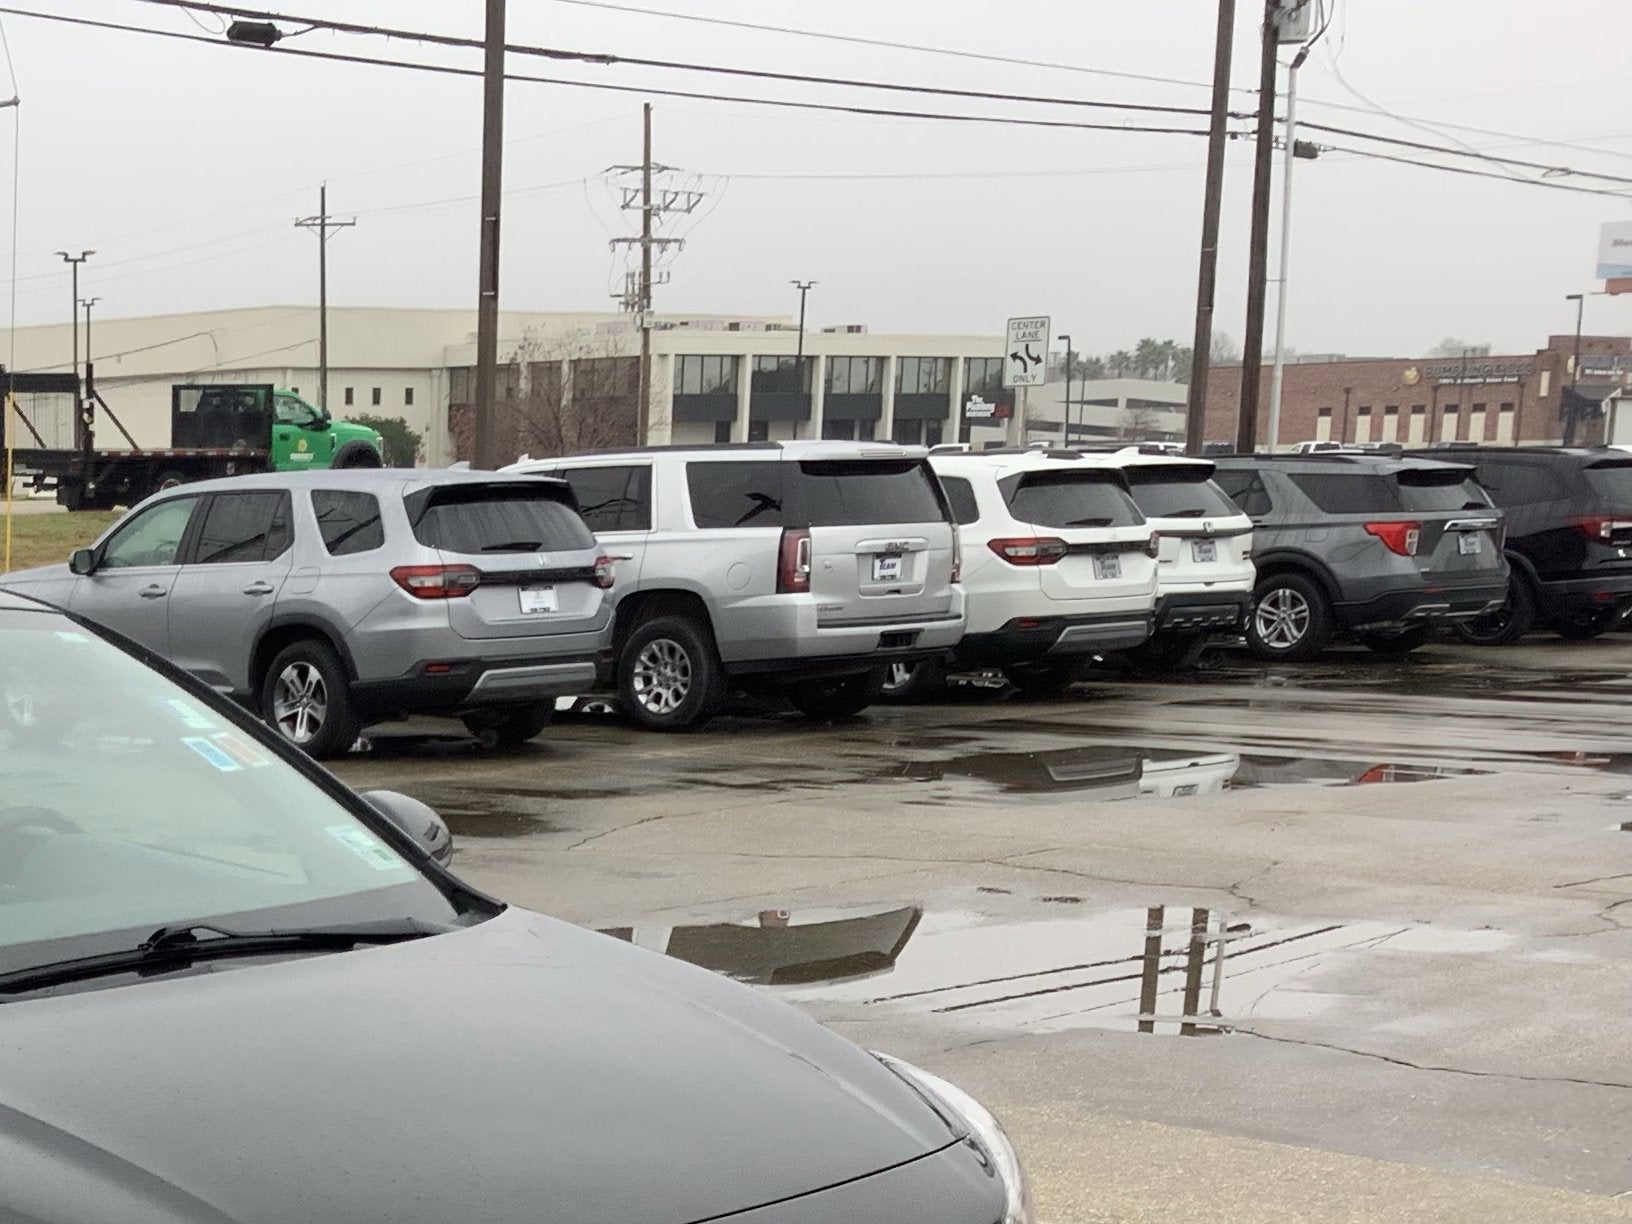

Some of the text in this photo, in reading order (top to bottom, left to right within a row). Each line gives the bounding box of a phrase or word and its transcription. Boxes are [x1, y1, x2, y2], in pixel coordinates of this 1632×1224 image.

[1011, 320, 1046, 331] CENTER
[1016, 330, 1040, 340] LANE
[1012, 373, 1038, 384] ONLY
